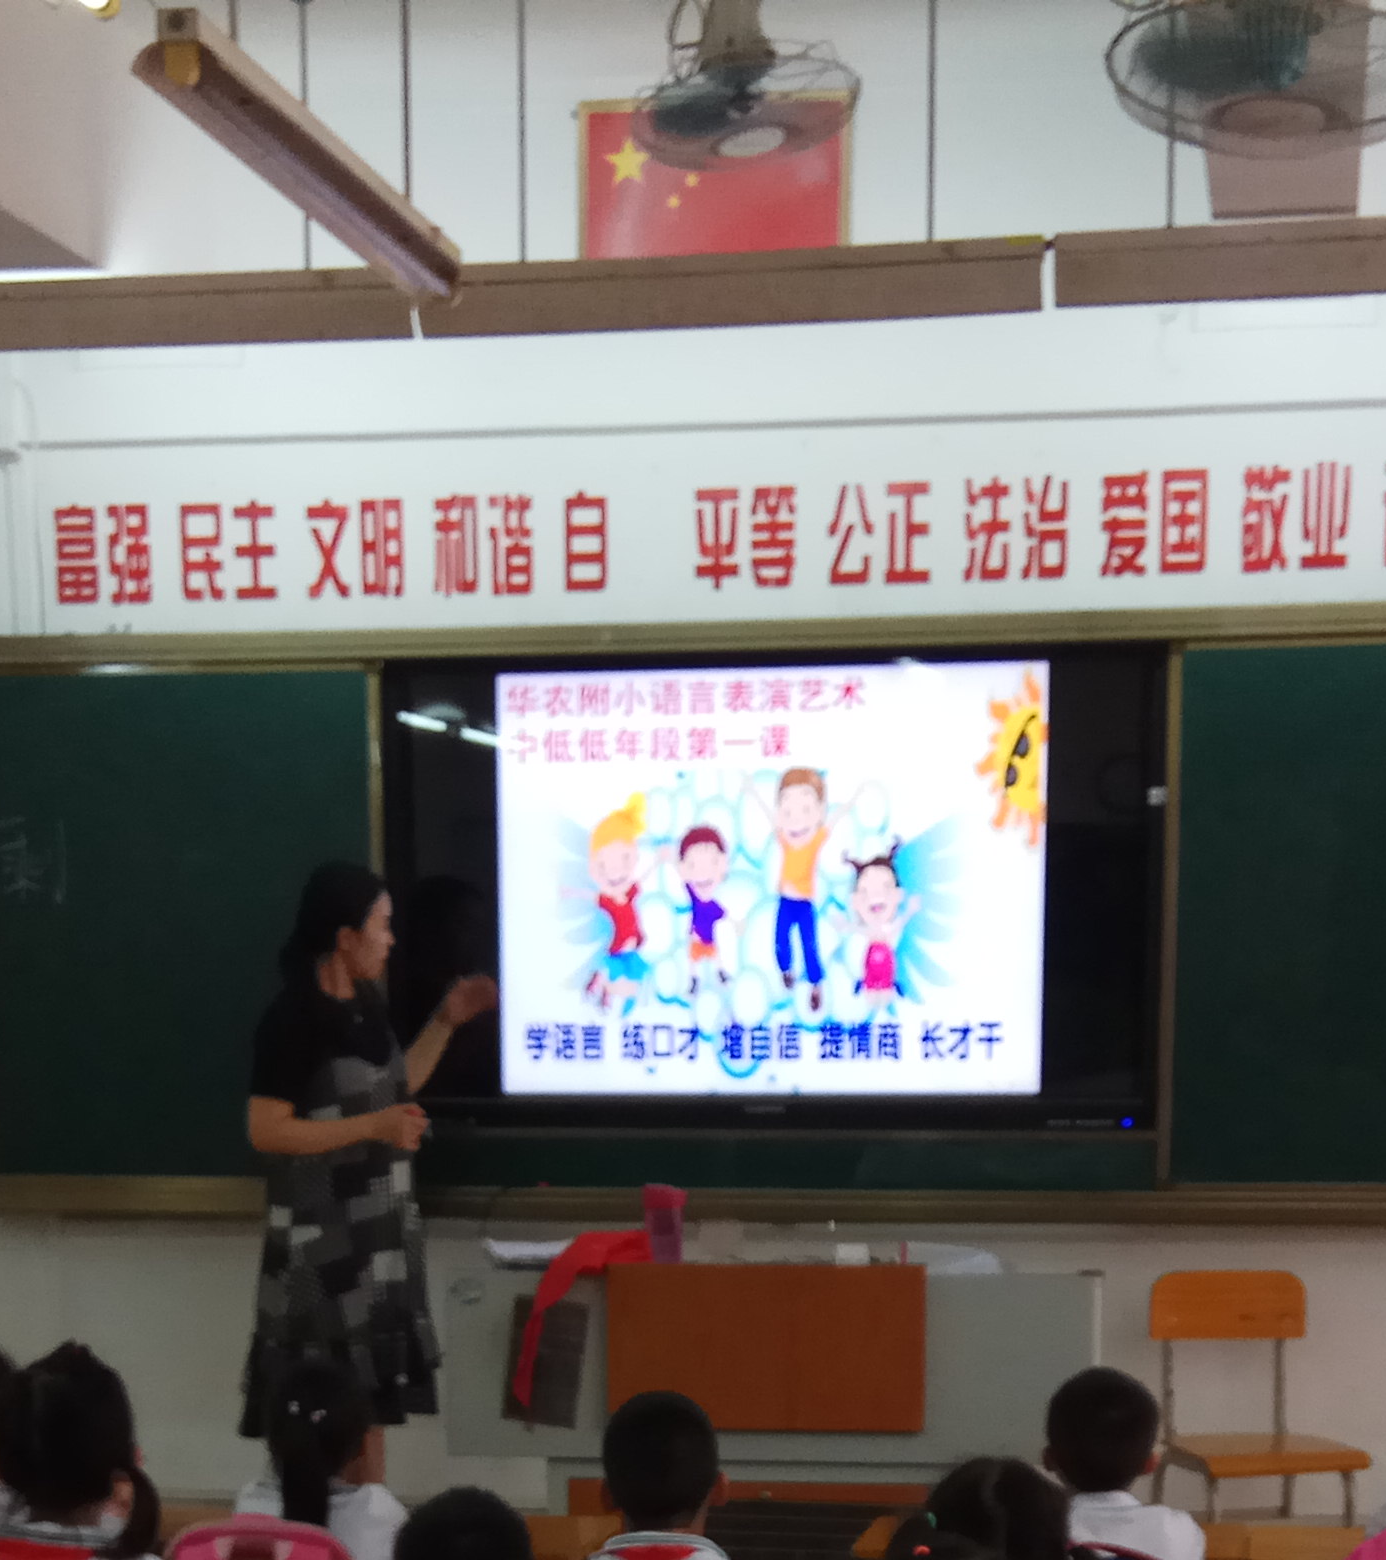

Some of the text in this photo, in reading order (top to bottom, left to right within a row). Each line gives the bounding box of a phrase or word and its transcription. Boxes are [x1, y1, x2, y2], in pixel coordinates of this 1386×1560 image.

[54, 503, 152, 605] 富强
[180, 501, 278, 602] 民主
[306, 499, 405, 599] 文明
[435, 495, 534, 598] 和谐
[565, 492, 608, 593] 自
[694, 485, 797, 590] 平等
[829, 481, 932, 586] 公正
[963, 475, 1070, 583] 法治
[1101, 469, 1210, 578] 爱国
[1241, 461, 1352, 575] 敬业
[525, 1021, 606, 1062] 学语言
[621, 1021, 701, 1062] 练口才
[718, 1022, 801, 1062] 增自信
[920, 1020, 1004, 1061] 长才干
